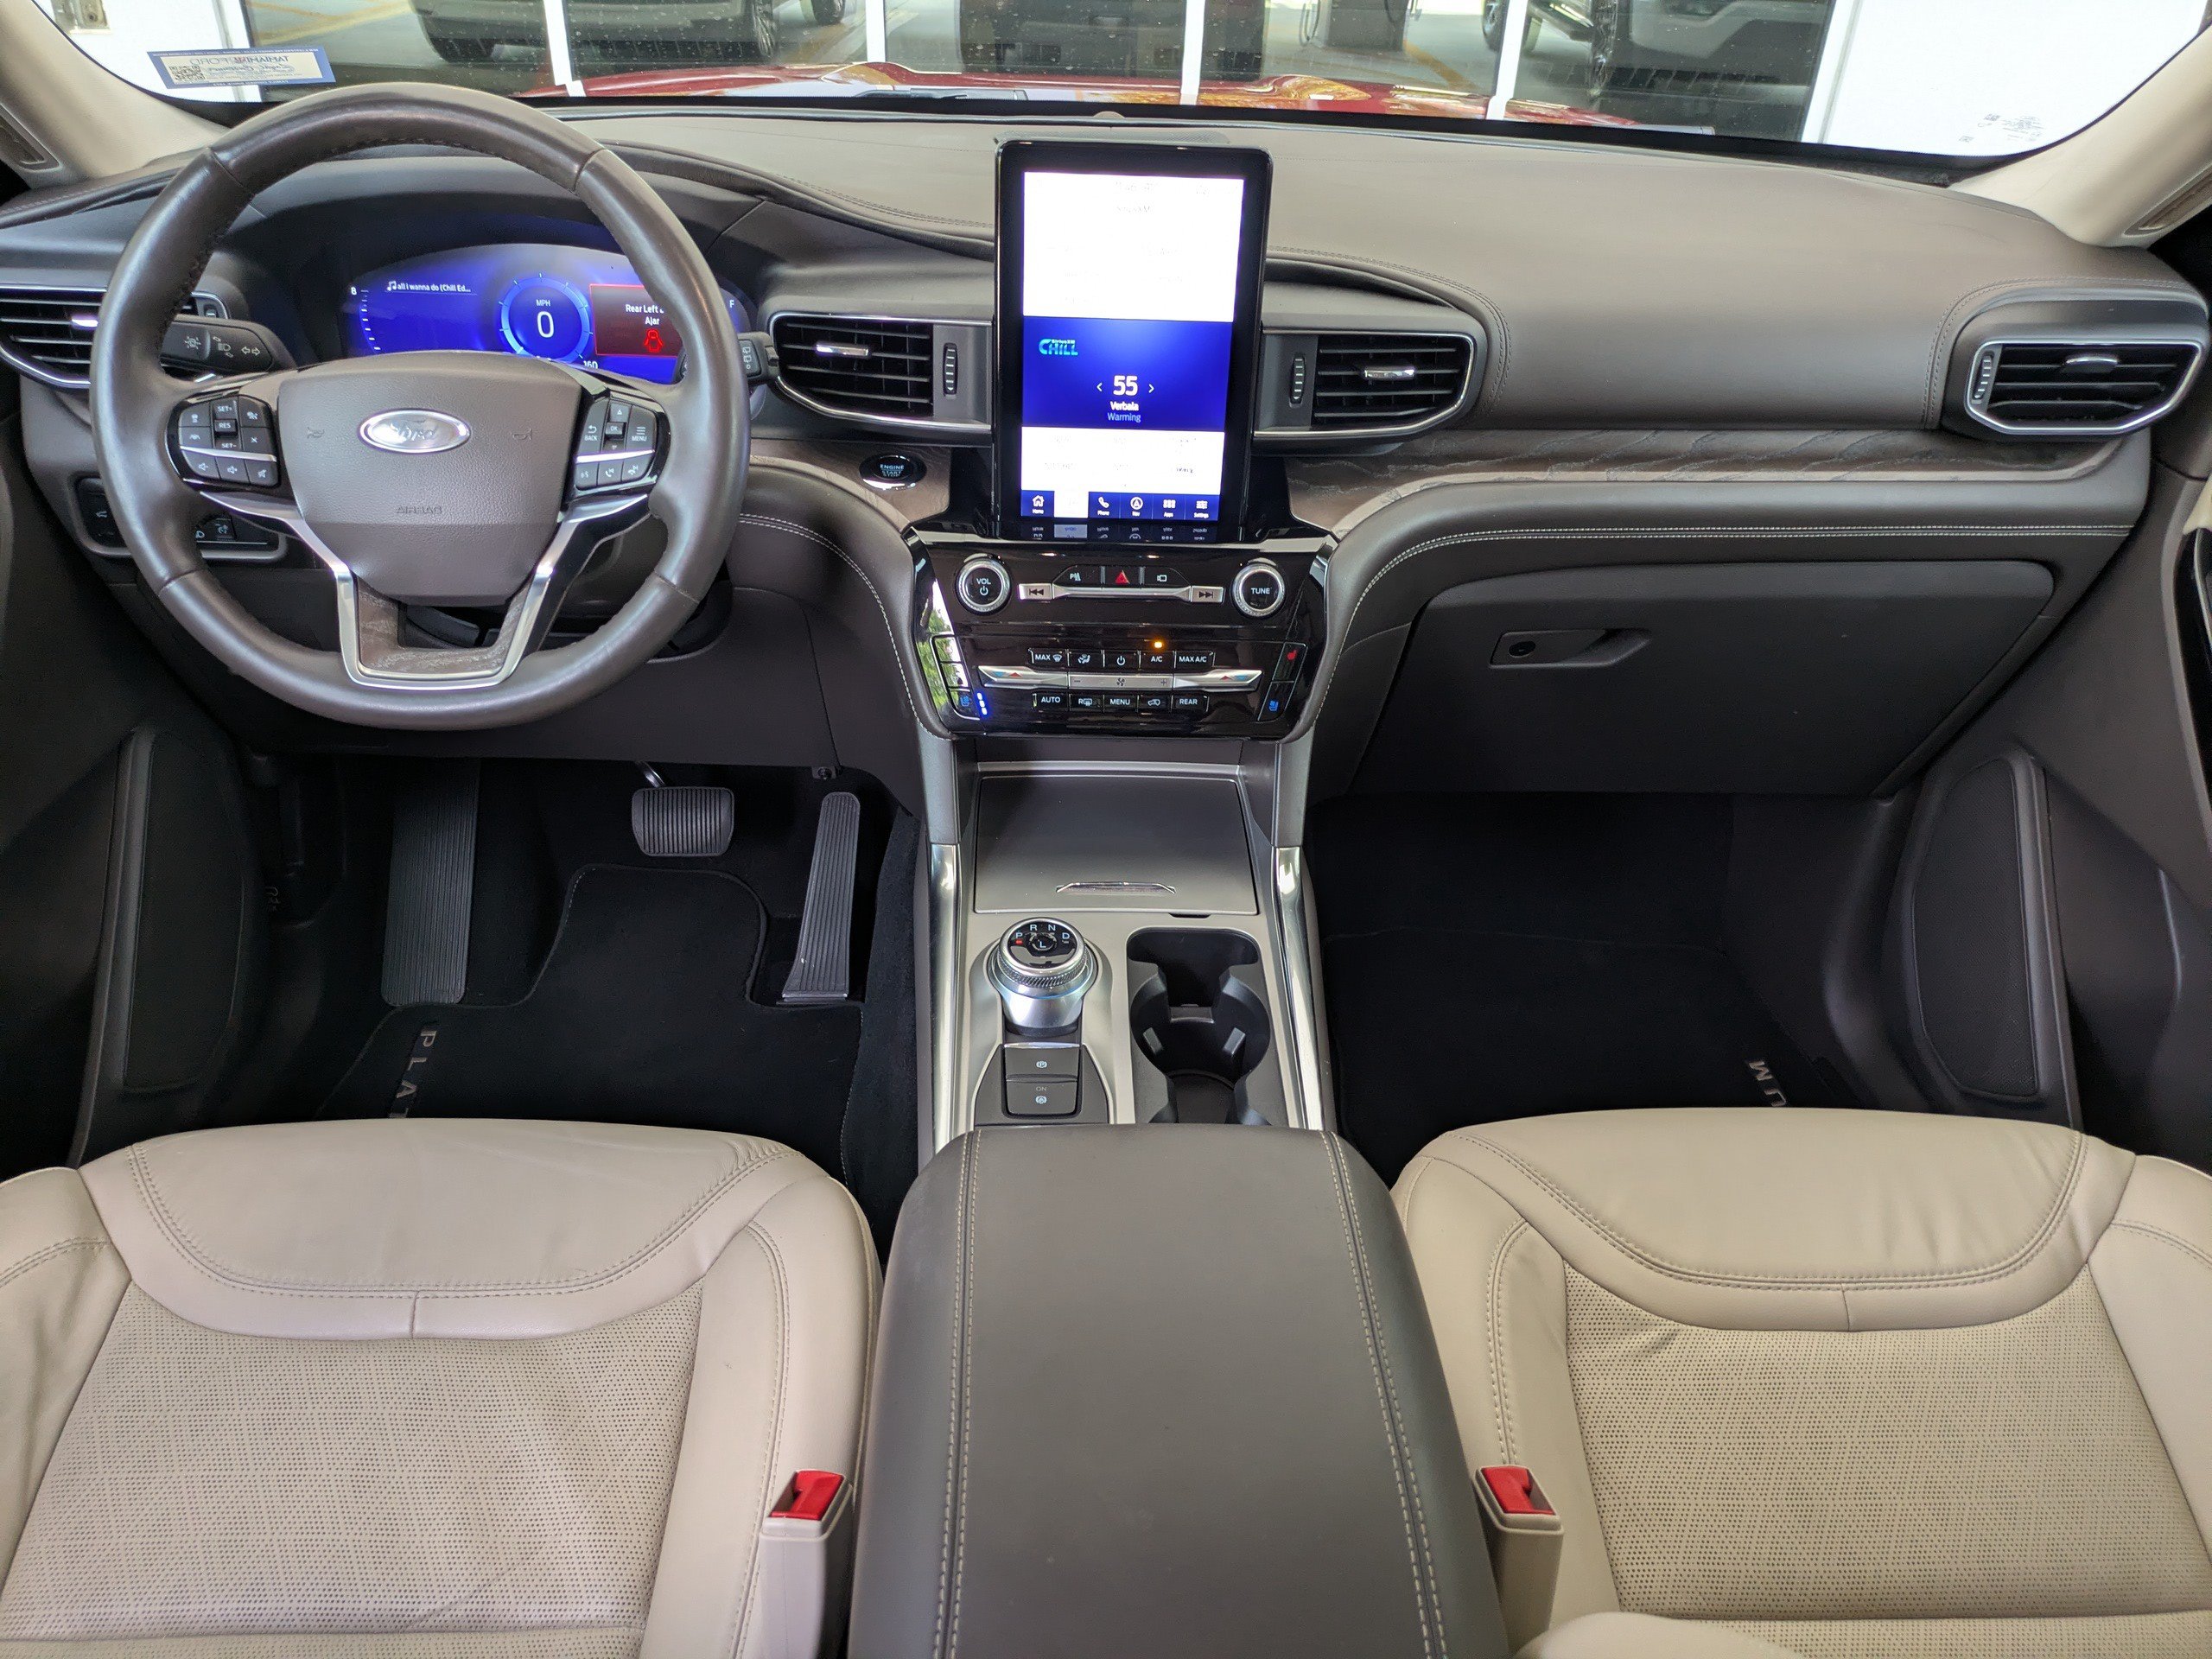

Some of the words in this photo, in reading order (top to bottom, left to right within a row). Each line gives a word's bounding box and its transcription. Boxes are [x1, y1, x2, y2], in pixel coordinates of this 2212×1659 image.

[626, 304, 642, 314] Rear
[644, 304, 658, 314] Left
[729, 299, 734, 308] F
[537, 311, 555, 339] 0
[645, 316, 660, 327] Ajar
[1039, 338, 1079, 356] CHILL
[1113, 375, 1138, 396] 55
[1107, 412, 1141, 423] Warming
